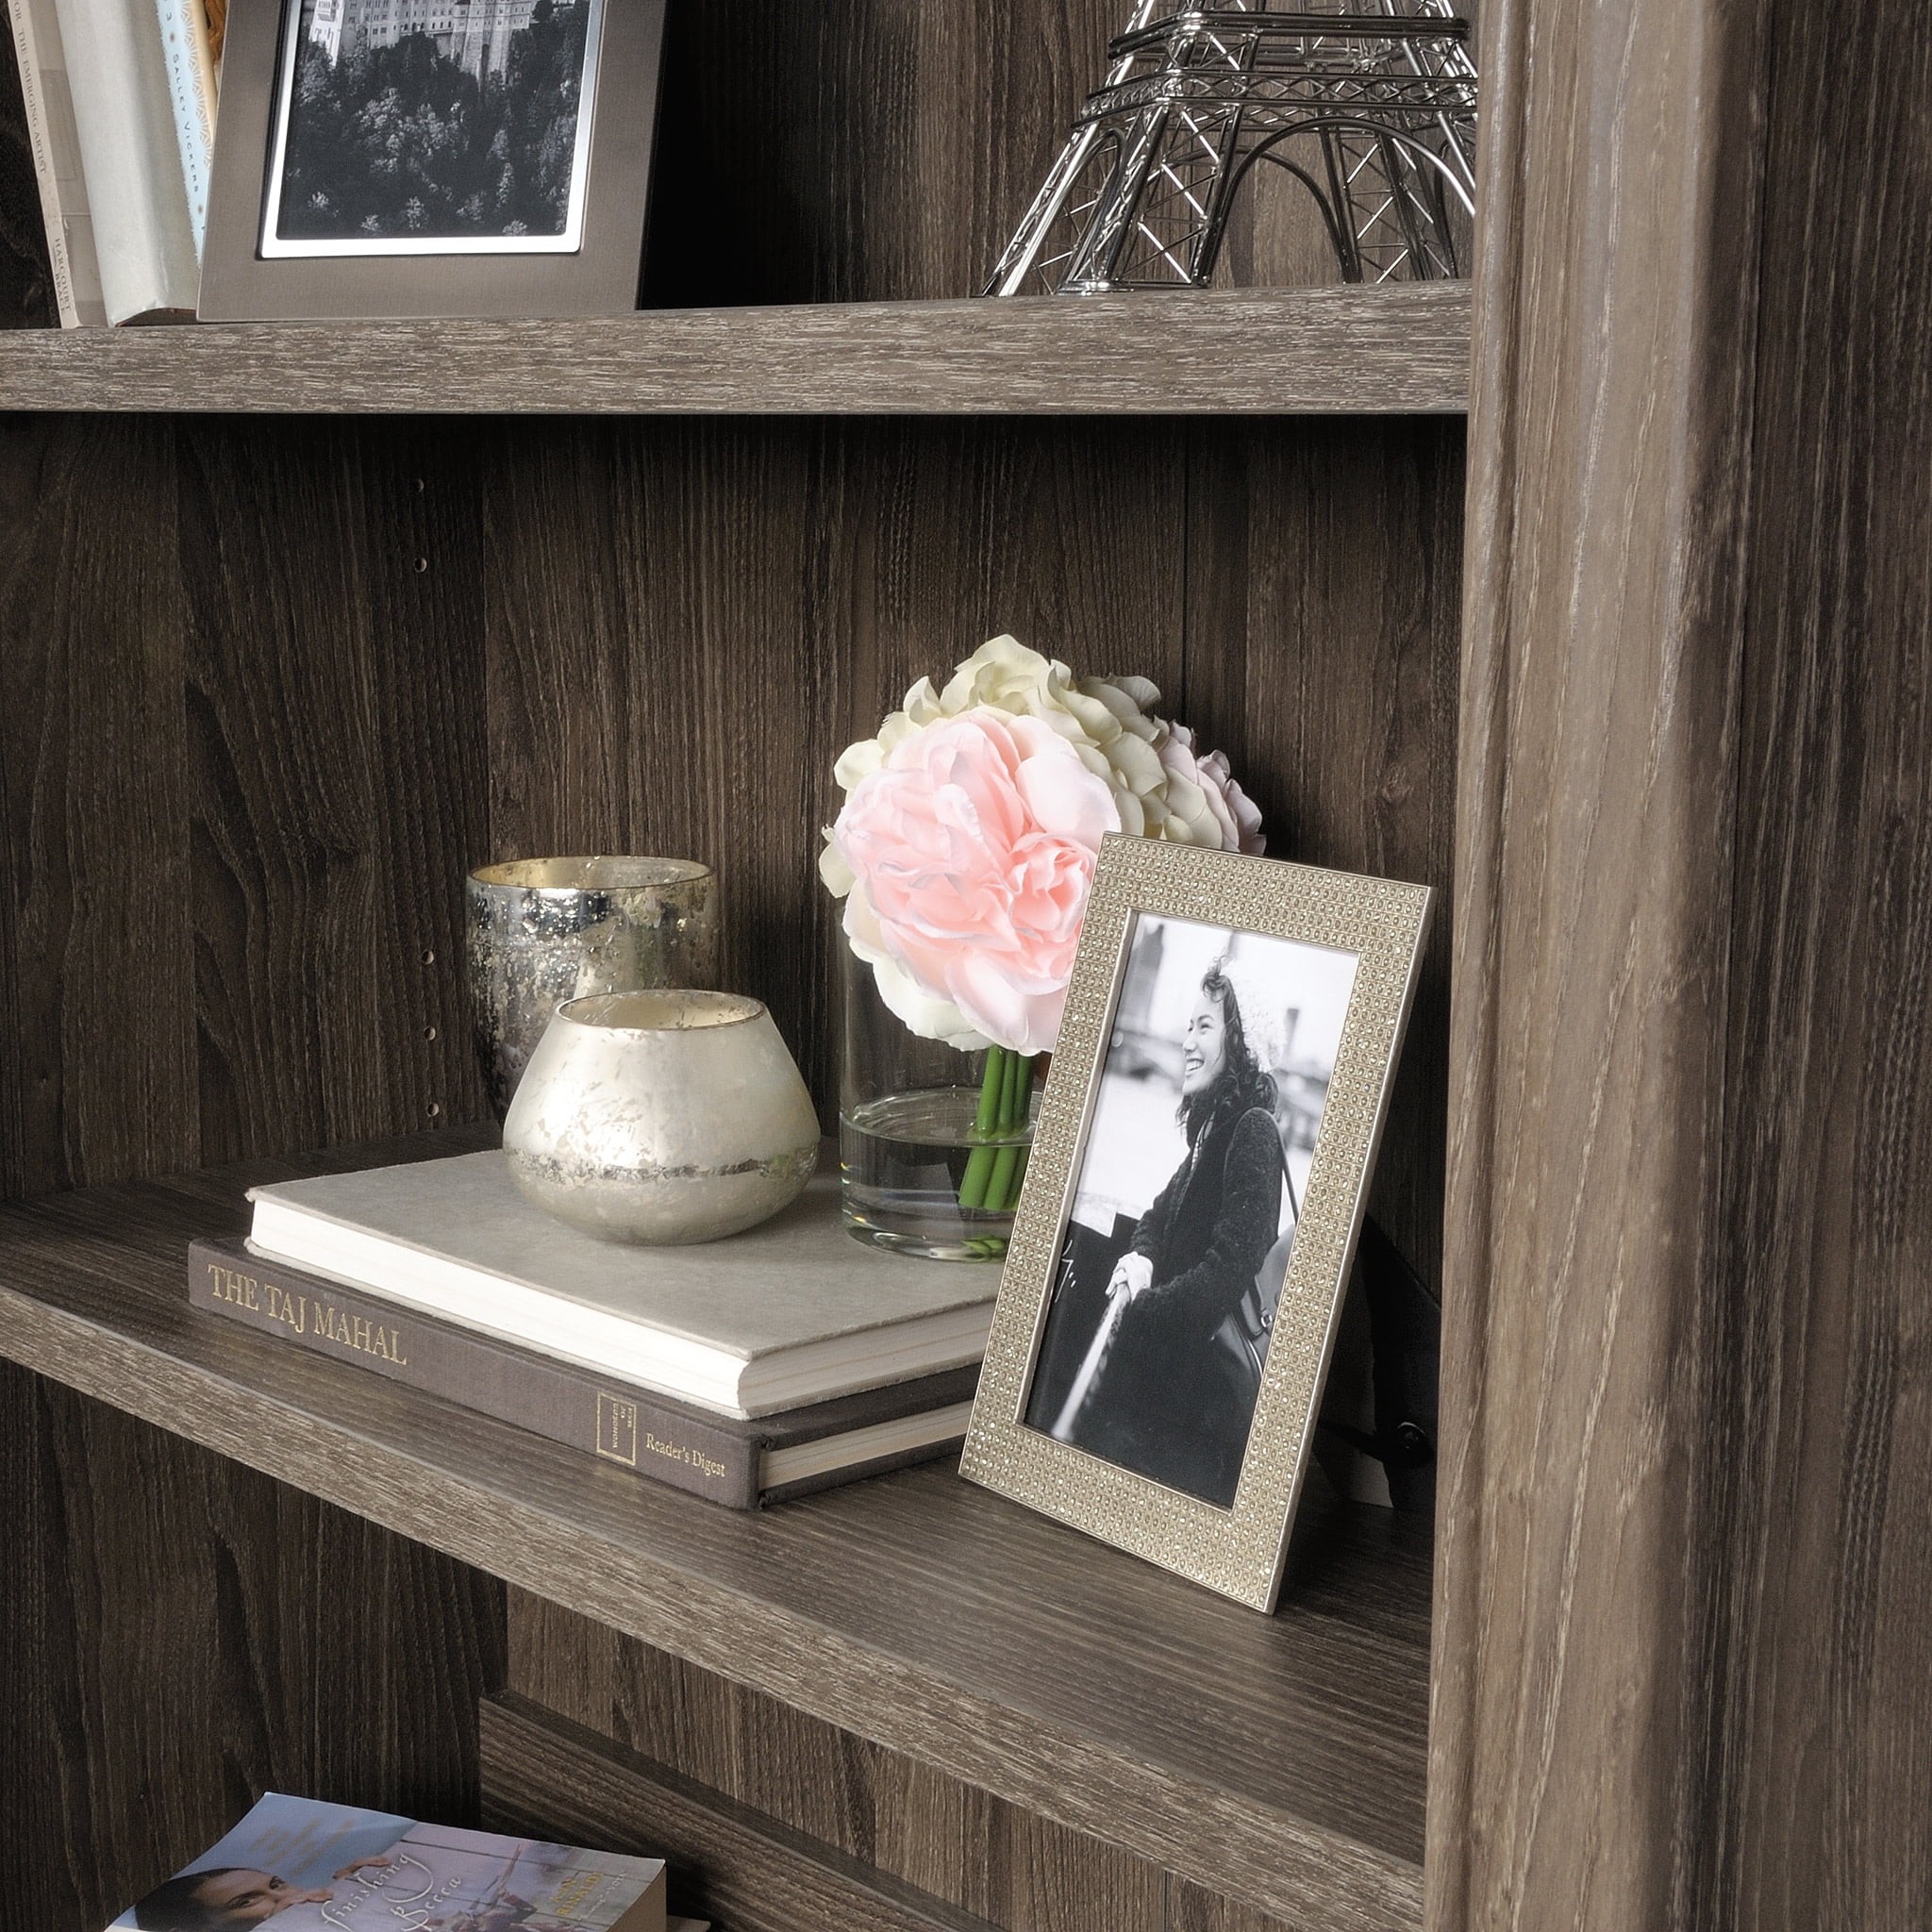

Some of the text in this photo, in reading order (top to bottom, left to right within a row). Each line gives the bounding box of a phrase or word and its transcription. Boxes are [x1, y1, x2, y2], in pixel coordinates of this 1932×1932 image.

[19, 28, 28, 55] THE
[23, 59, 39, 127] EMERGING
[173, 53, 186, 112] SALLEY
[184, 121, 199, 193] VICKERS
[34, 131, 47, 175] ARTIST
[55, 238, 72, 311] HARCOURT
[208, 1263, 408, 1366] THE TAJ MAHAL
[645, 1432, 725, 1477] Reader's Digest
